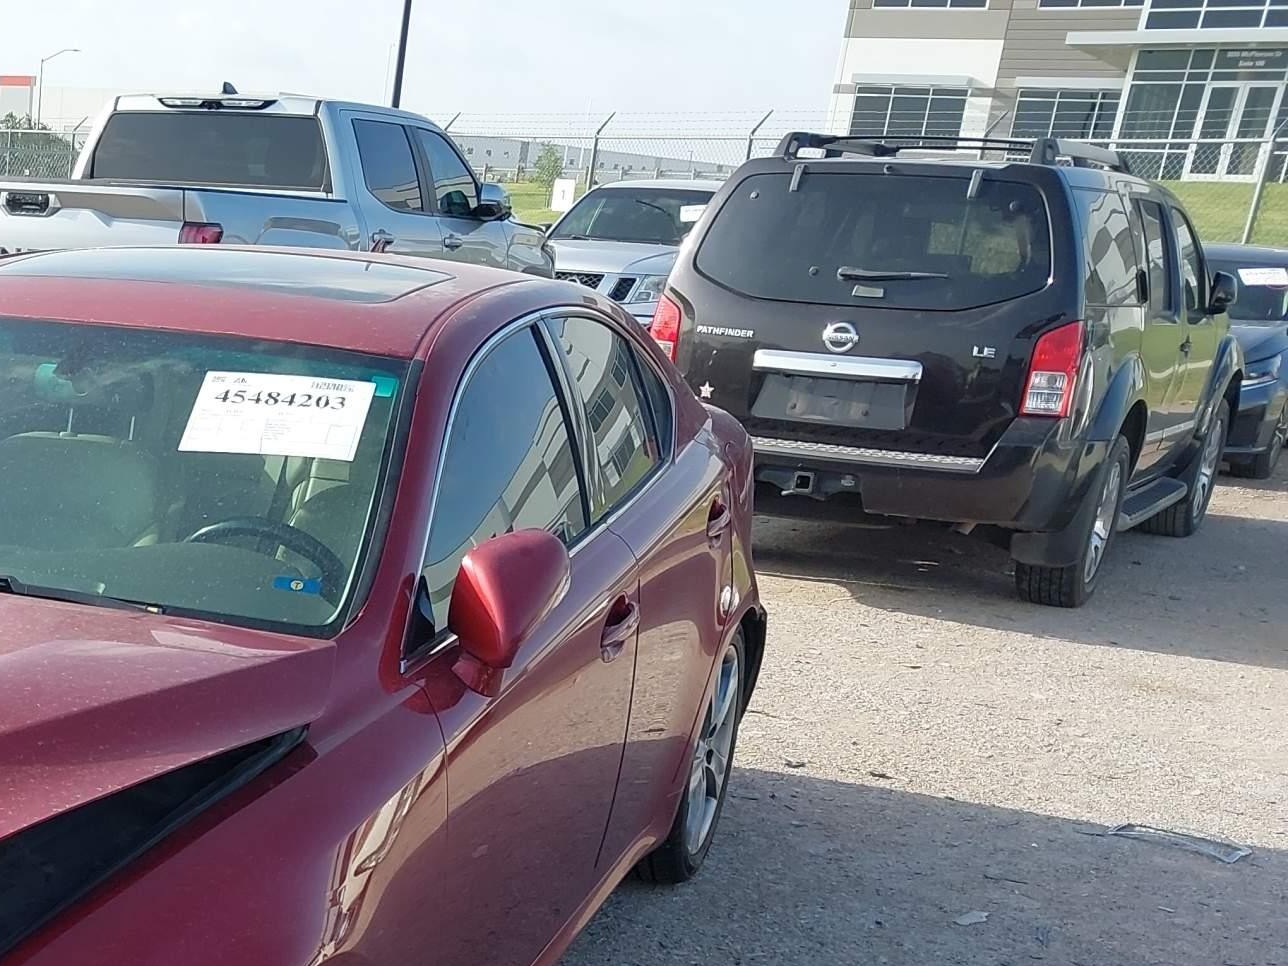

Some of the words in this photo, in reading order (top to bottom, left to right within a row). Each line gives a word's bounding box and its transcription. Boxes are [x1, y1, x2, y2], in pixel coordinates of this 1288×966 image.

[696, 325, 754, 338] PATHFINDER
[972, 345, 997, 359] LE
[214, 388, 347, 411] 45484203
